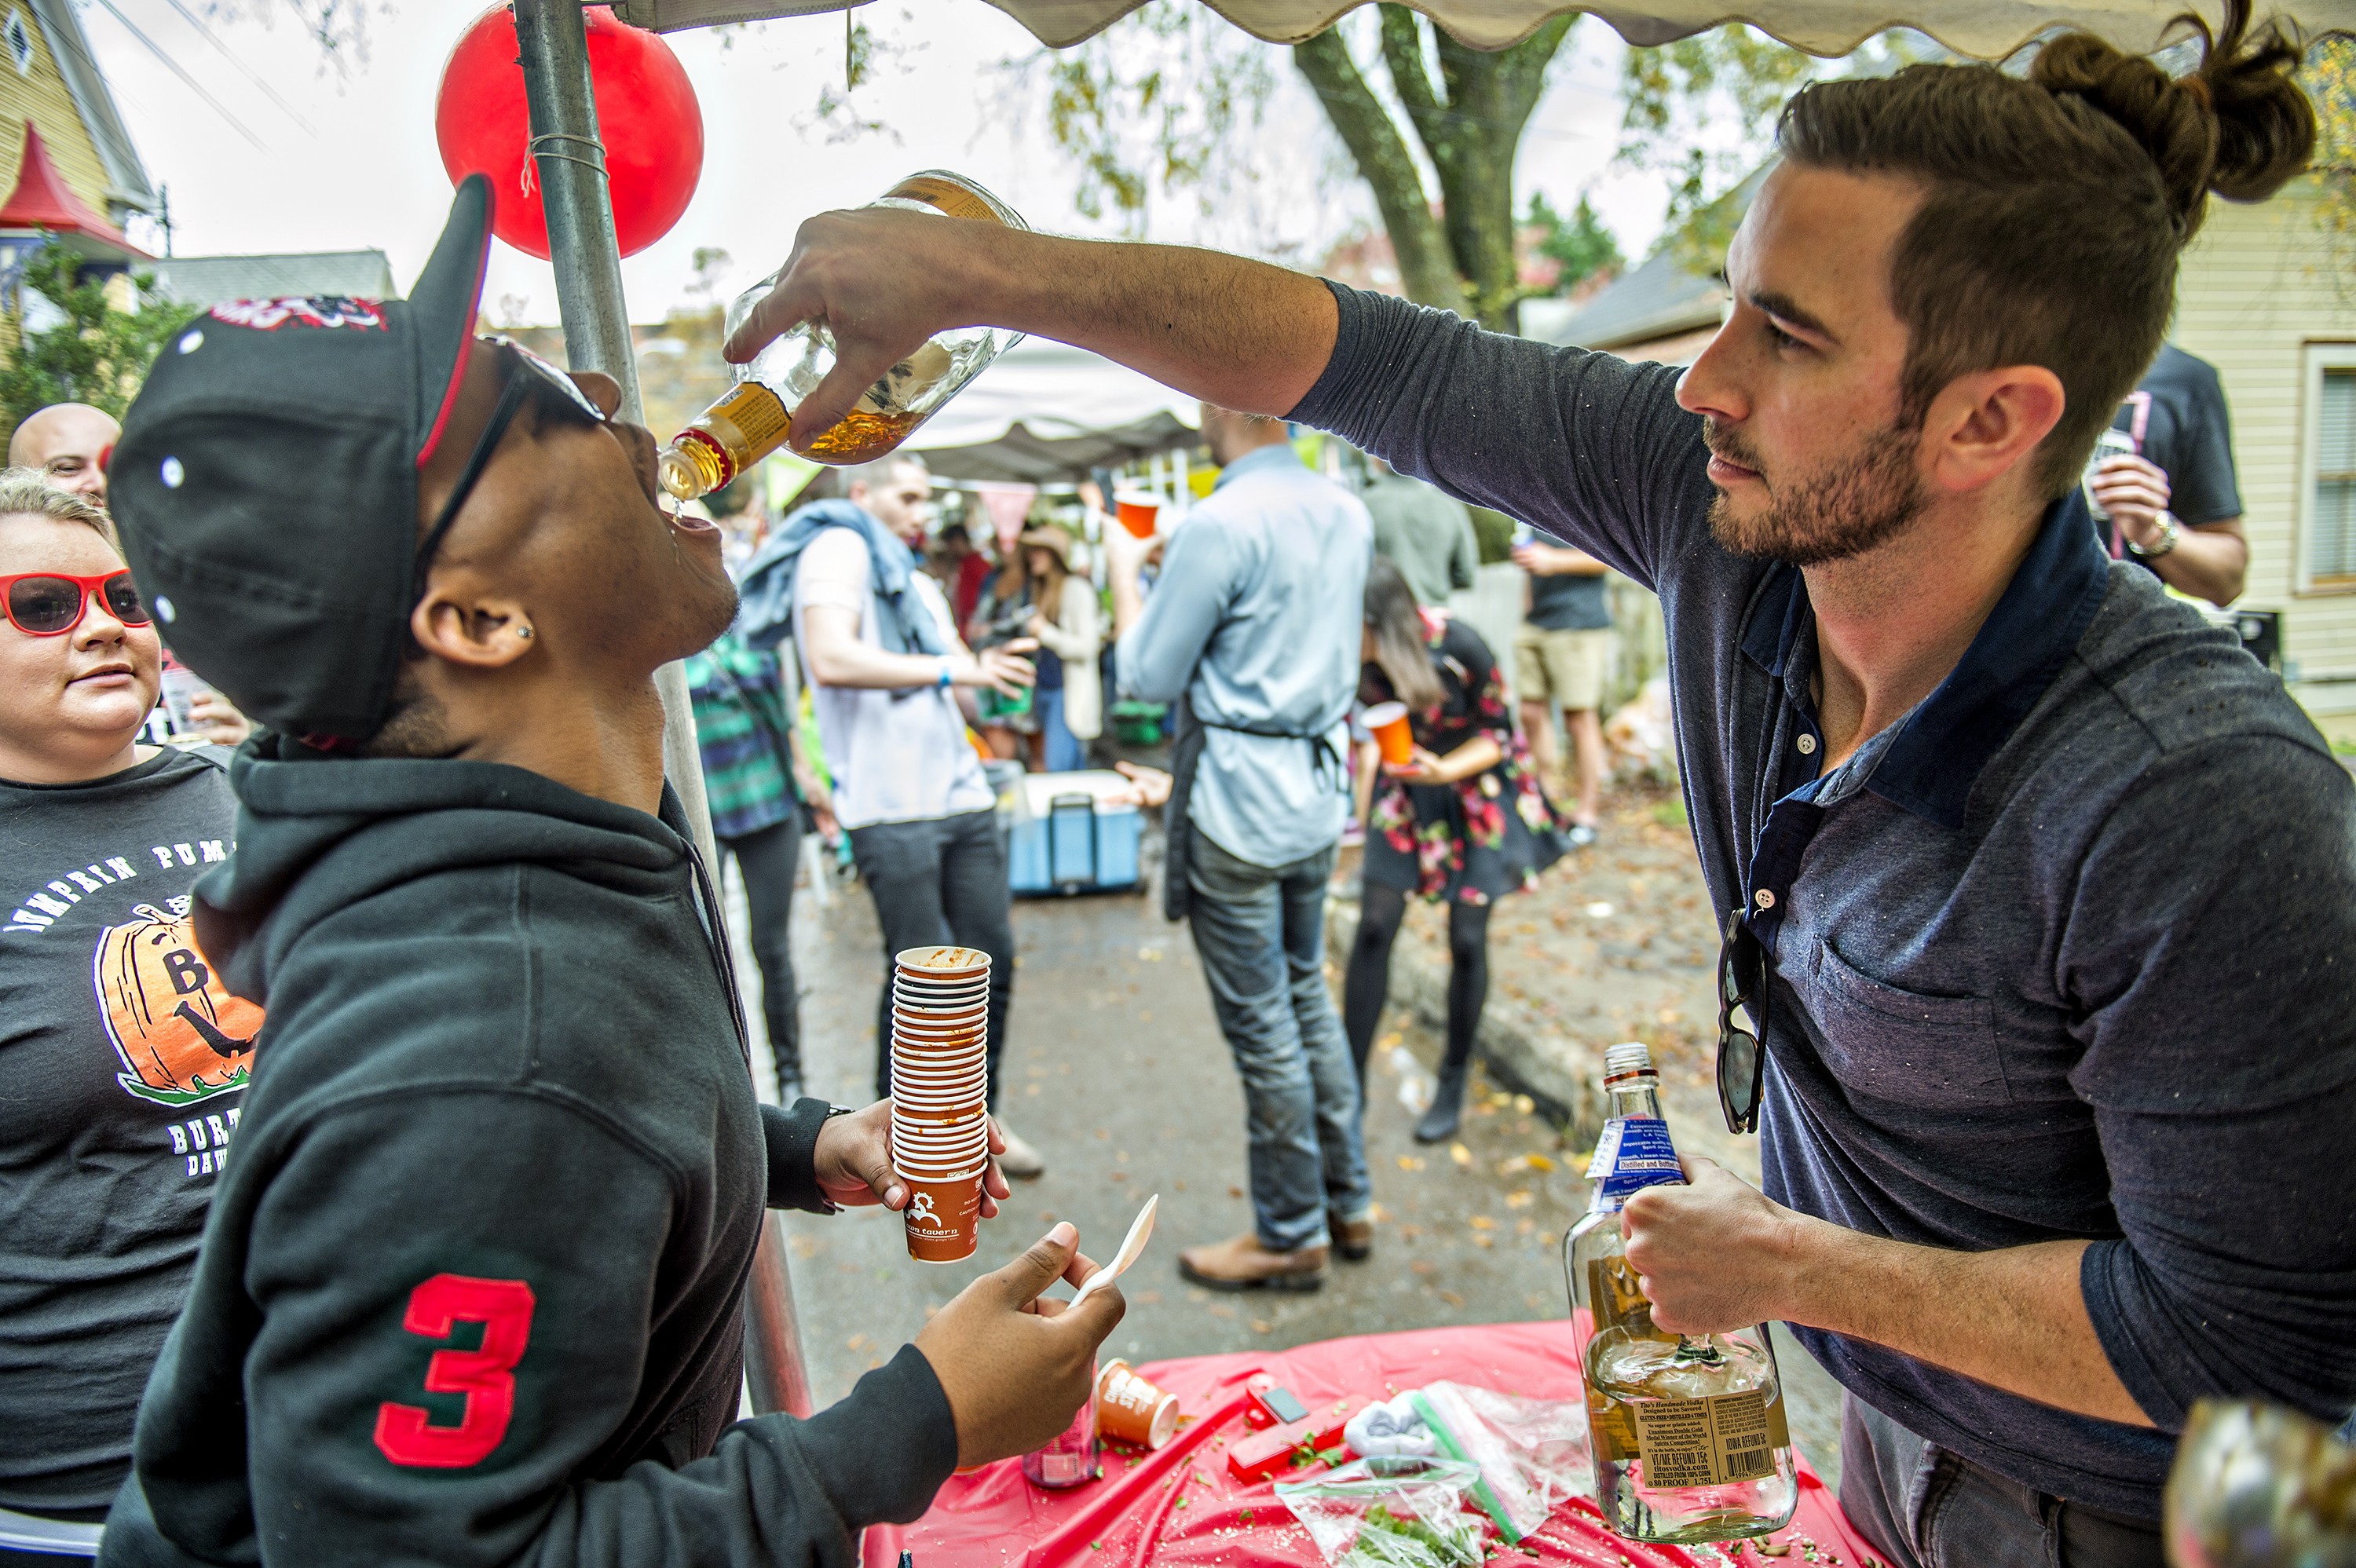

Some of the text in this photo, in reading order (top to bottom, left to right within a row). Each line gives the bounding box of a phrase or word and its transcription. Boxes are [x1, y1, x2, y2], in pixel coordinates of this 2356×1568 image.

[151, 839, 236, 869] PUM
[163, 948, 208, 995] B
[166, 1107, 242, 1155] BURT
[186, 1148, 228, 1177] DAW
[373, 1272, 538, 1468] 3
[1726, 1437, 1742, 1450] IOWA
[1741, 1433, 1761, 1449] REFUND
[1652, 1451, 1708, 1466] VT/ME REFUND 15¢
[1654, 1464, 1708, 1472] titosvodka.com
[1694, 1477, 1714, 1486] 1.75L
